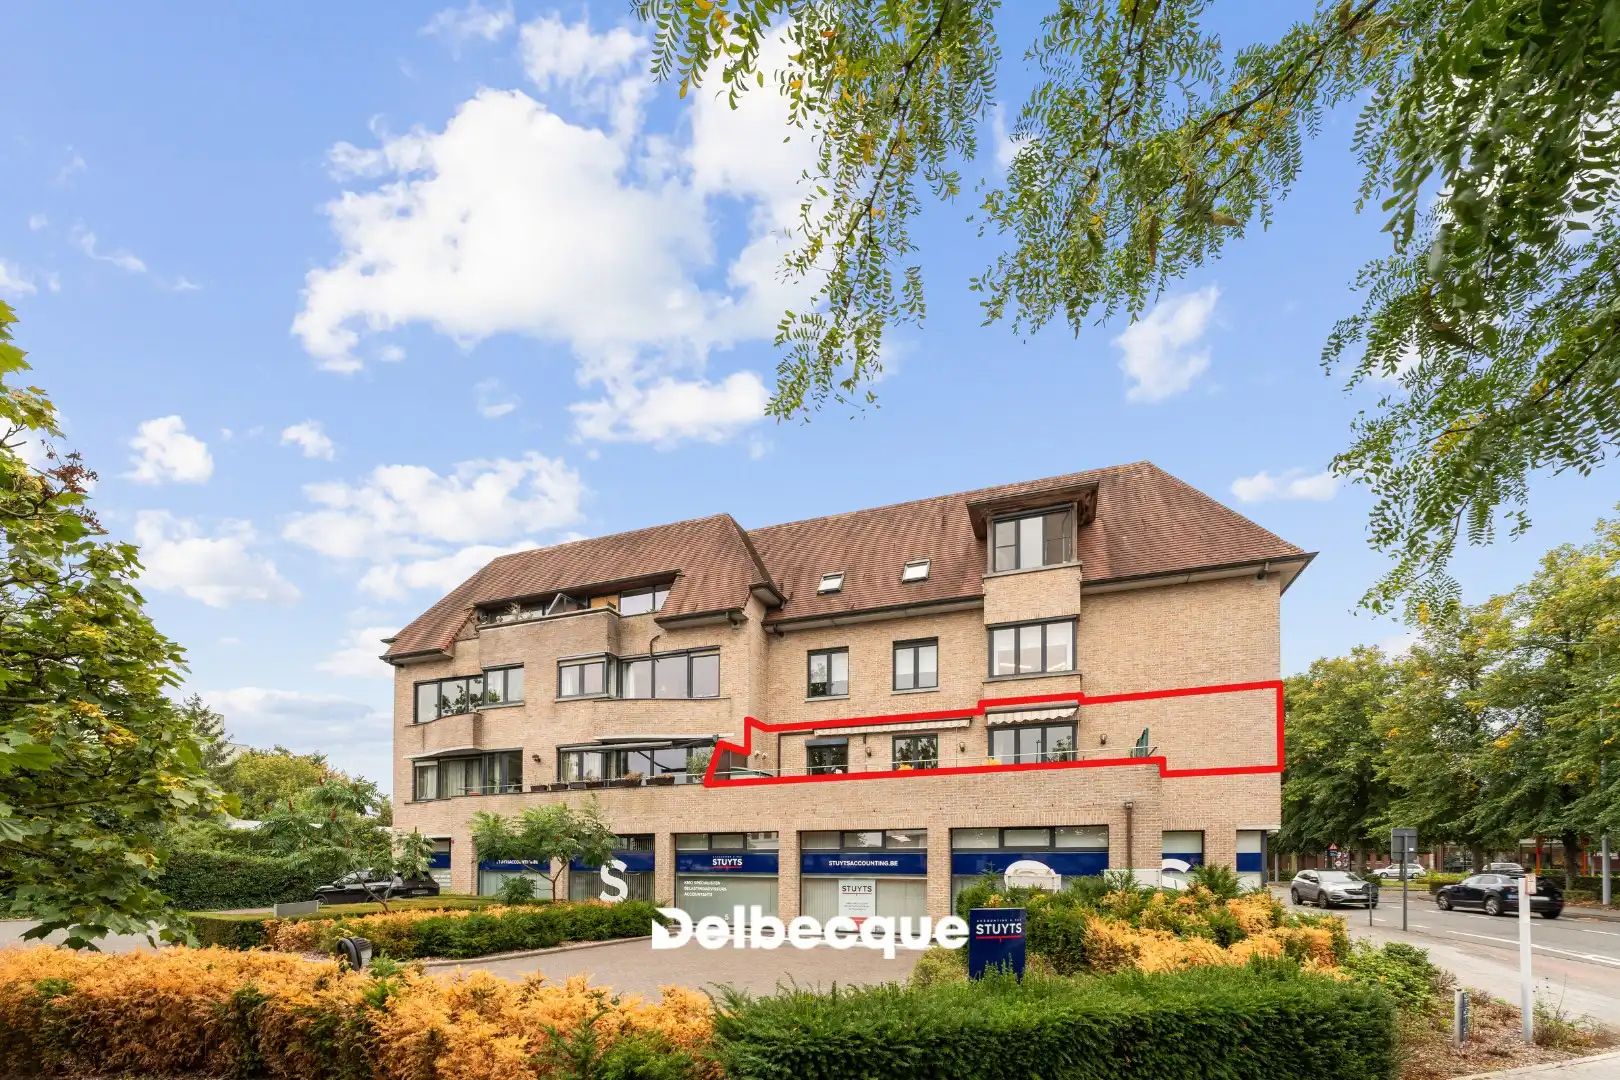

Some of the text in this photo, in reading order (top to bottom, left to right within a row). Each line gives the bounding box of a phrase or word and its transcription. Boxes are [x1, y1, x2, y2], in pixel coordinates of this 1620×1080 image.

[712, 858, 743, 866] STUYTS
[600, 859, 628, 904] S
[841, 885, 873, 893] STUYTS
[975, 923, 1022, 935] STUYTS
